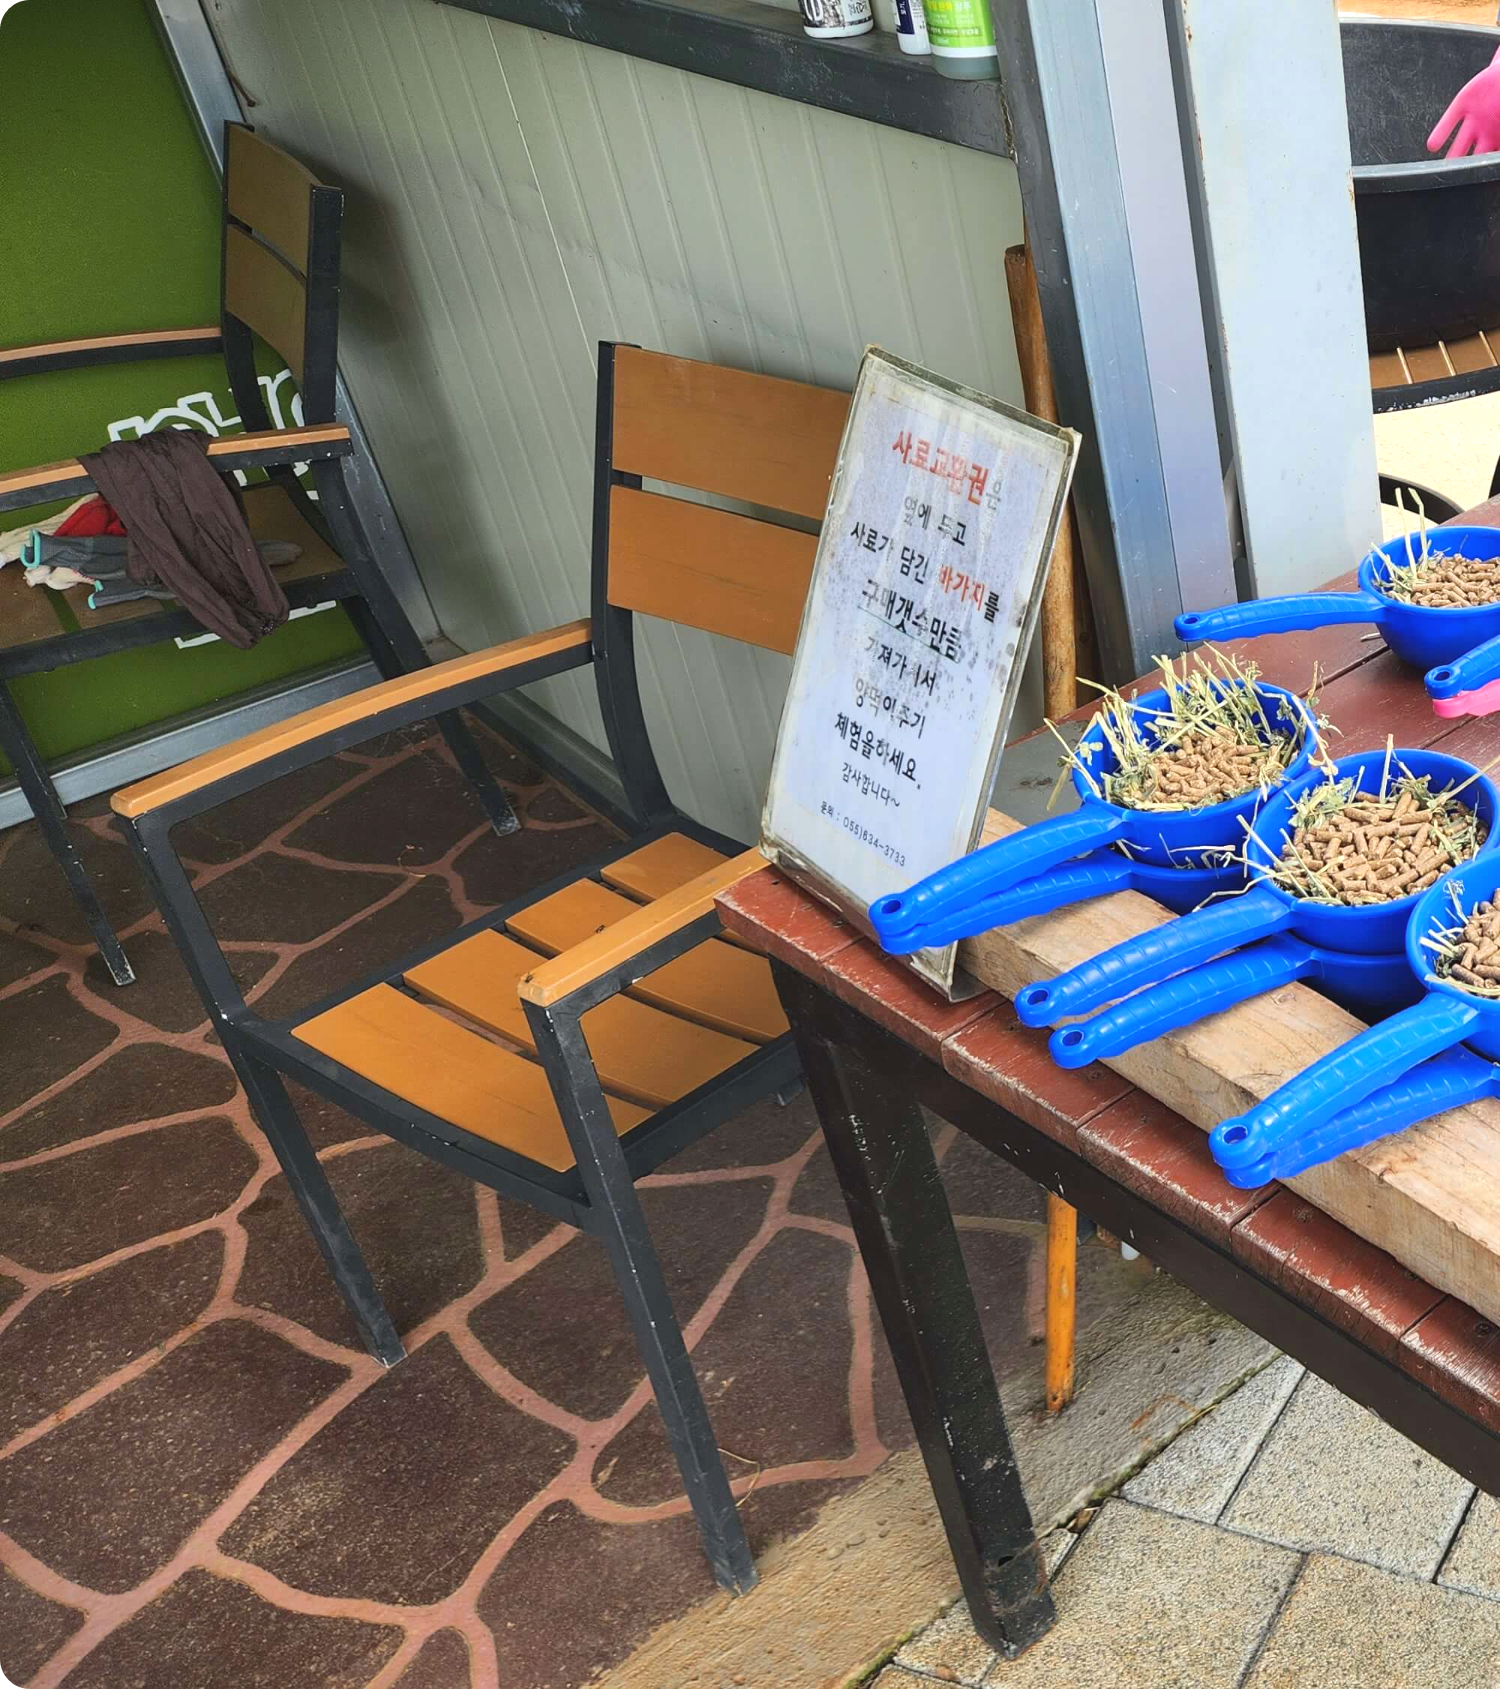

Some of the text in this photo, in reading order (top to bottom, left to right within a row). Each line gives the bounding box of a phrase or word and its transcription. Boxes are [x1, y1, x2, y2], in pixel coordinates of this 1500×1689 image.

[938, 514, 967, 546] 두고
[850, 522, 1000, 623] 사료가 담긴 바가지를
[834, 712, 922, 790] 체험을하세요.
[842, 762, 901, 807] 감사합니다~
[842, 816, 906, 867] 055)634-3733
